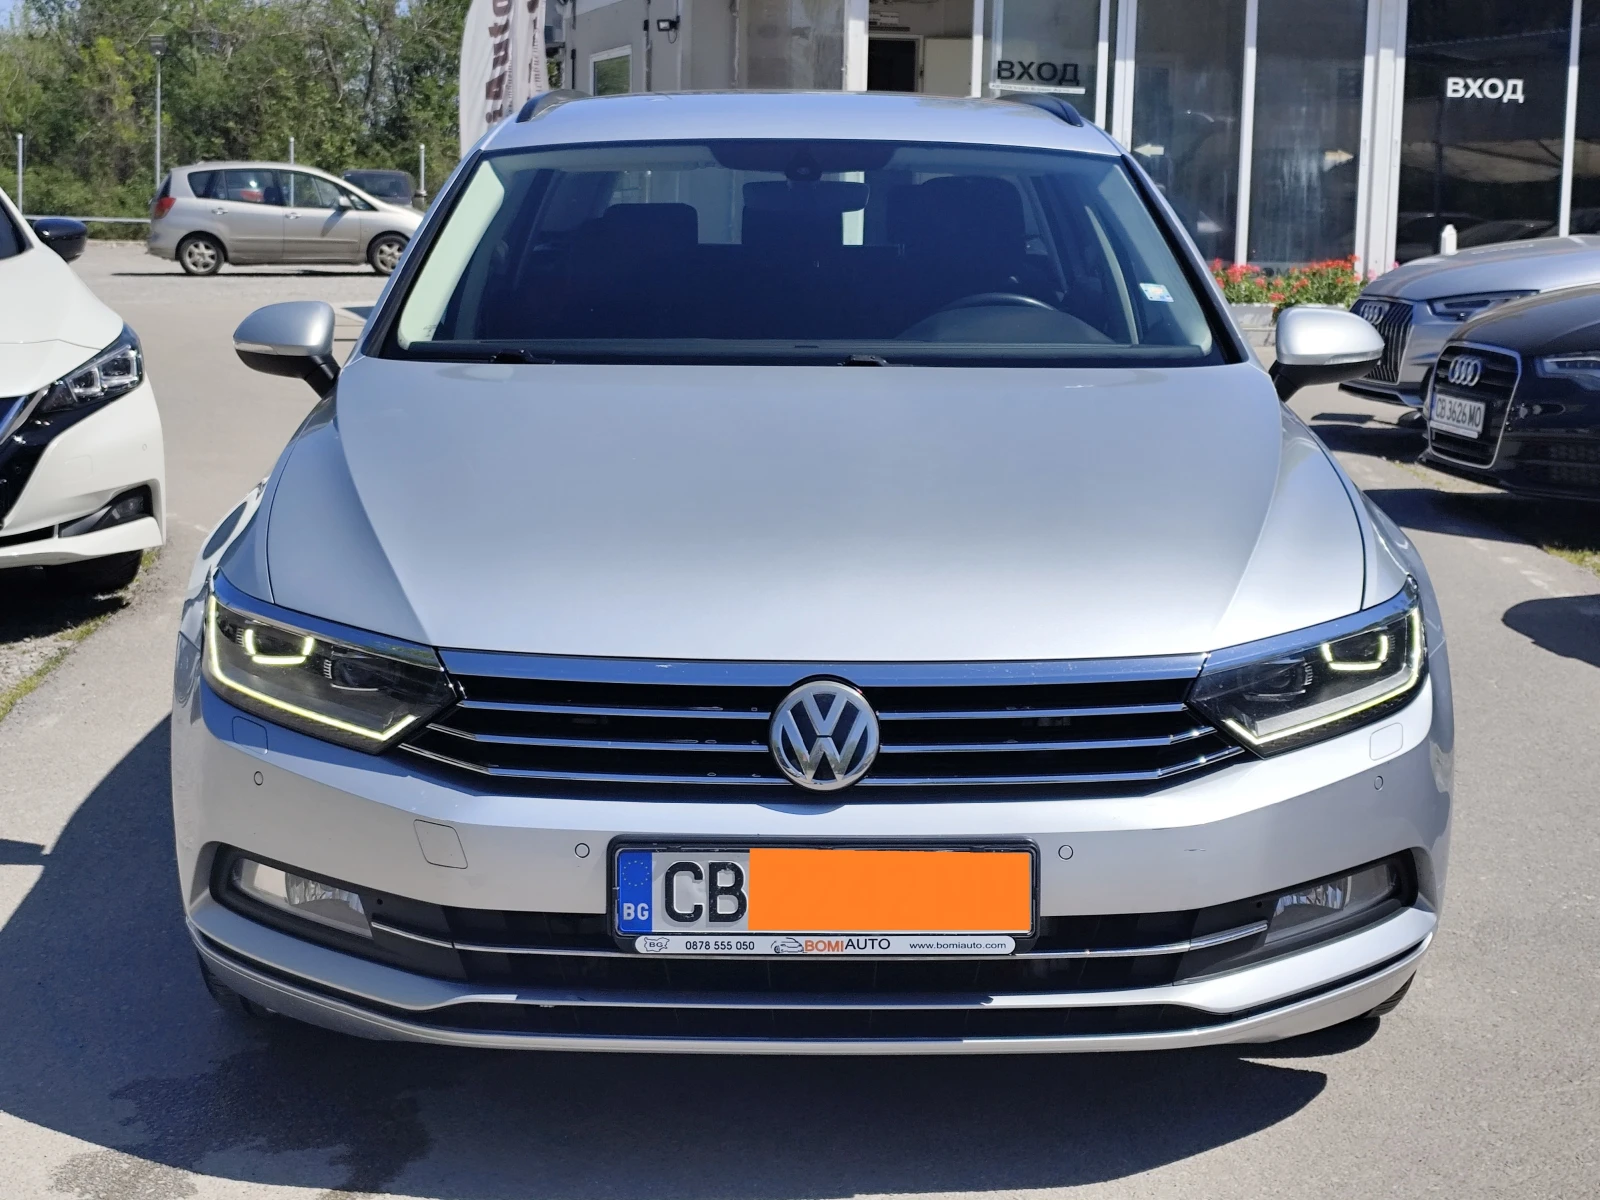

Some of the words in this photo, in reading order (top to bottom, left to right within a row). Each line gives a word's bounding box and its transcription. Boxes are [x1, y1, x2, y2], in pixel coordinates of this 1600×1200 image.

[997, 61, 1079, 86] ВХОД
[1446, 77, 1524, 103] ВХОД
[1446, 401, 1467, 423] 3626
[771, 682, 878, 789] VW
[623, 903, 649, 920] BG
[685, 941, 711, 950] 0878
[714, 941, 732, 950] 555
[735, 941, 755, 950] 050
